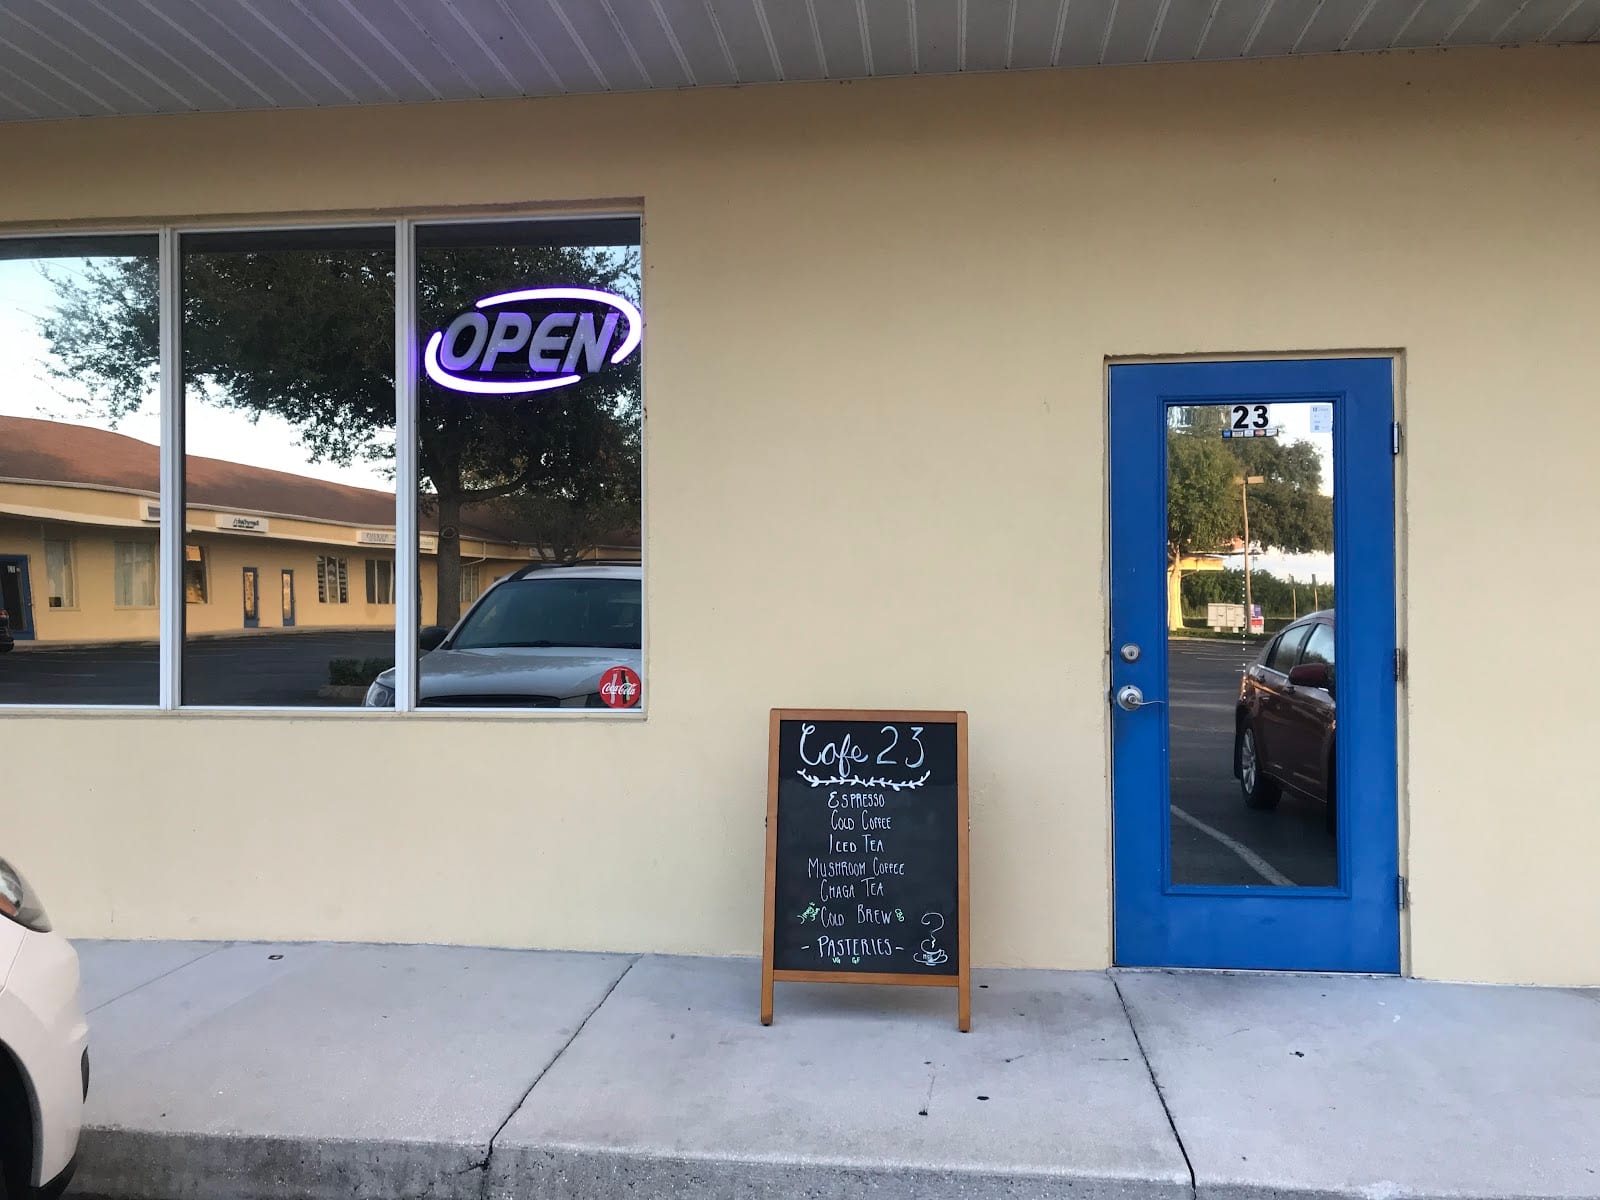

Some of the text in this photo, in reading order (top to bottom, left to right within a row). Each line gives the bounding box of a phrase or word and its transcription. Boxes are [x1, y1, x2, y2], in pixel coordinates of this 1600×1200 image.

[440, 311, 619, 373] OPEN
[1232, 405, 1269, 429] 23
[800, 723, 925, 777] Cafe 23
[827, 791, 885, 809] ESPRESSO
[861, 809, 892, 830] COFFEE
[829, 834, 884, 854] ICED TEA
[808, 857, 905, 878] MUSHROOM COFFEE
[820, 877, 884, 902] CHAGA TEA
[857, 904, 892, 925] BREW
